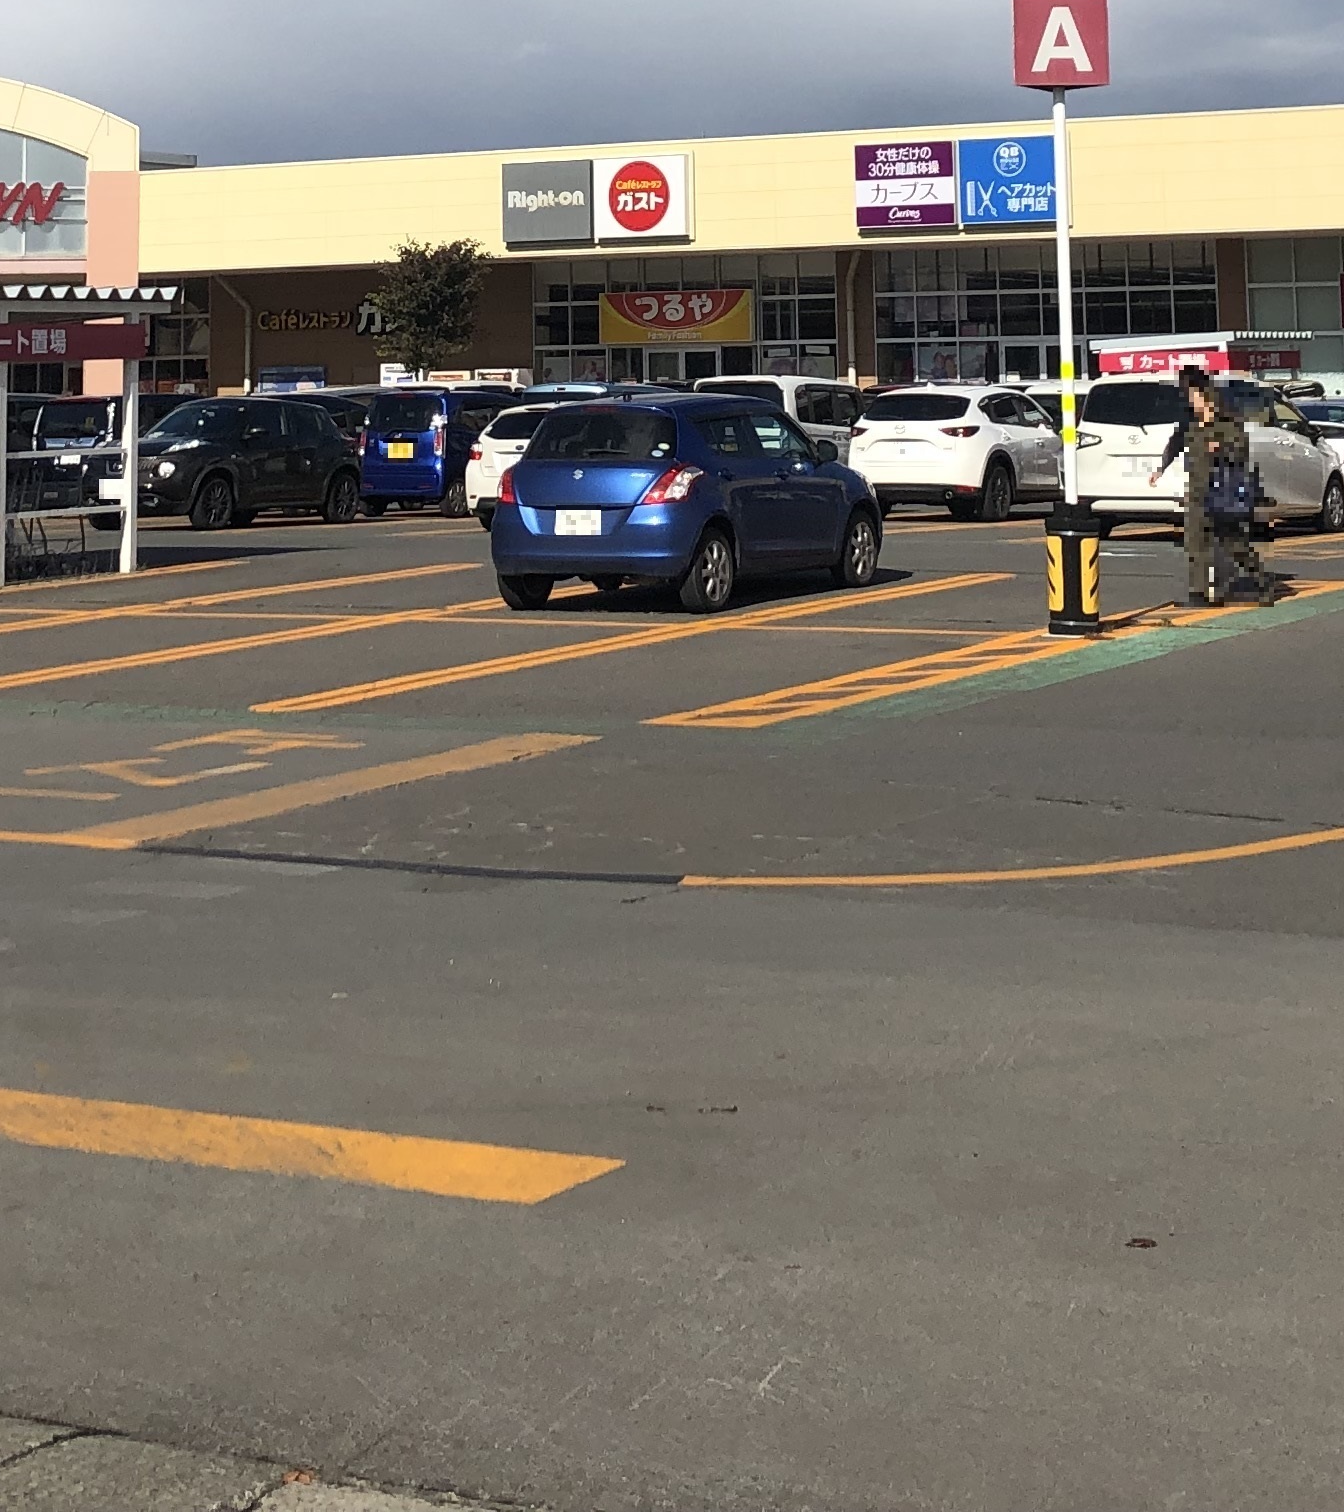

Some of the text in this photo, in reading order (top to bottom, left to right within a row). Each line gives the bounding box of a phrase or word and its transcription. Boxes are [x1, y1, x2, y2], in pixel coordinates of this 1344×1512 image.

[1031, 7, 1093, 72] A
[875, 147, 931, 162] 女性だけの
[999, 146, 1019, 157] QB
[870, 182, 939, 203] カーブス
[997, 182, 1056, 196] ヘアカット
[507, 191, 585, 212] Right-on
[617, 191, 664, 211] ガスト
[1007, 197, 1048, 212] 専門店
[635, 293, 713, 321] つるや
[257, 309, 353, 331] Caféレストラン
